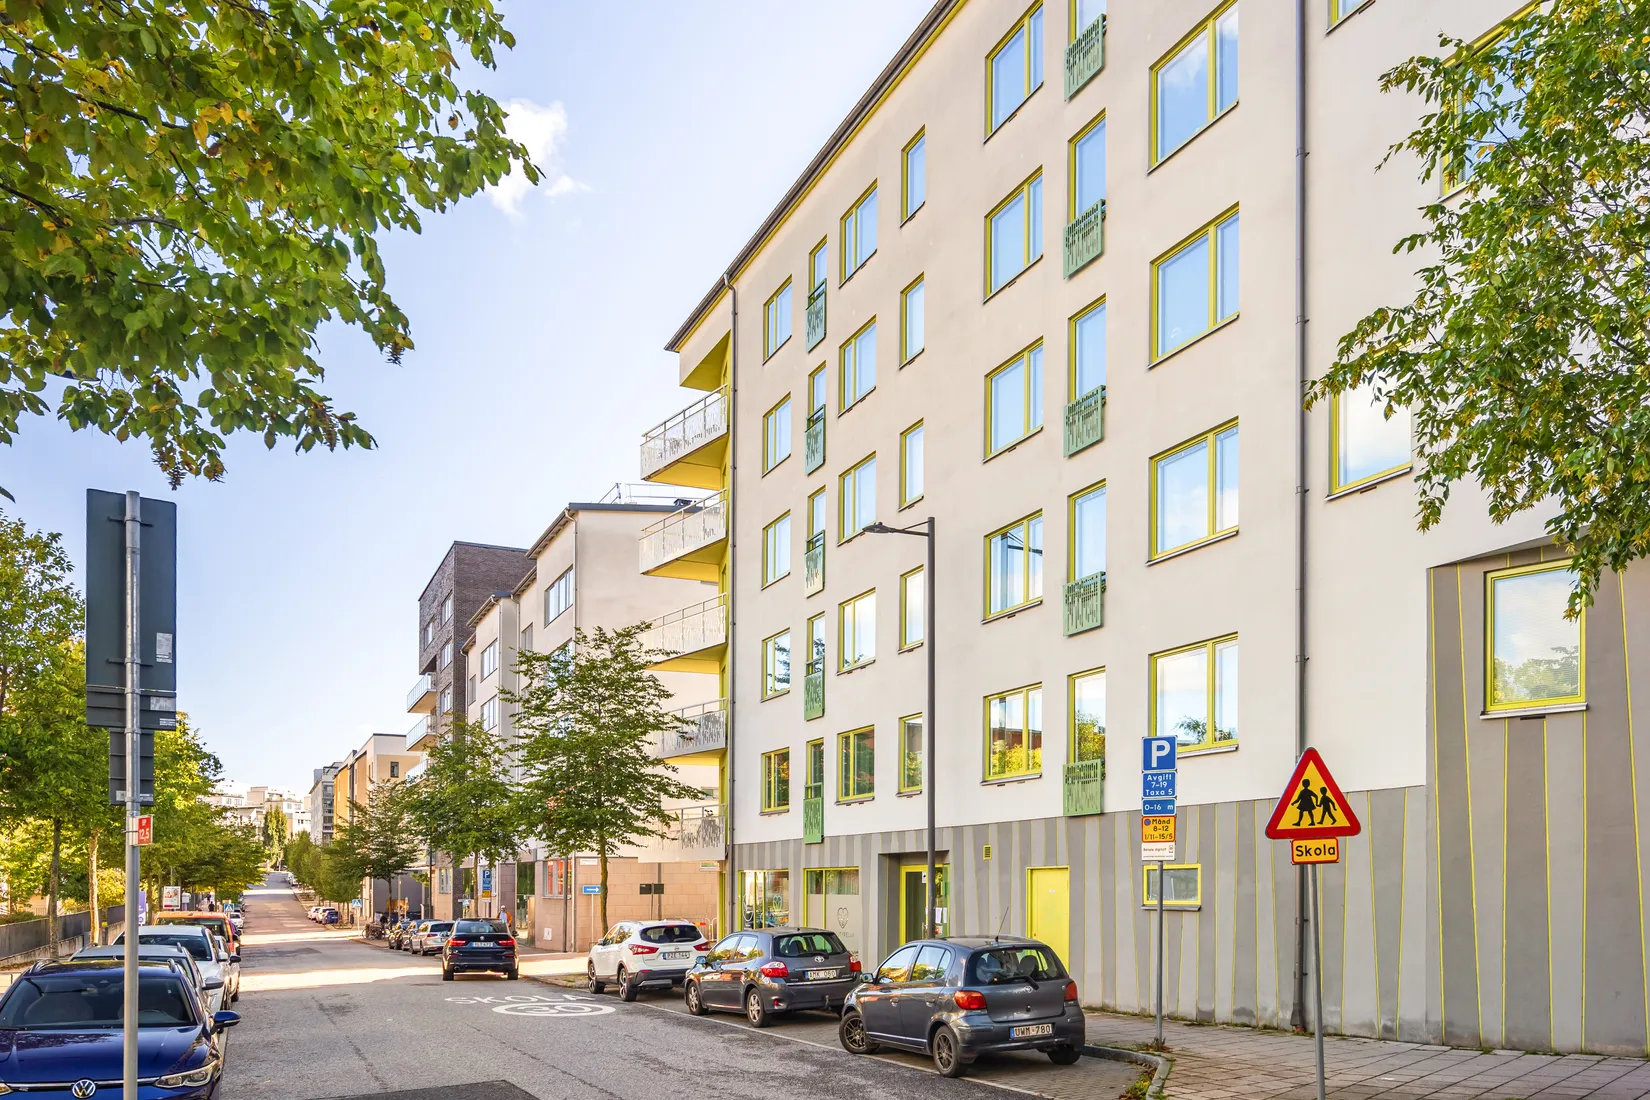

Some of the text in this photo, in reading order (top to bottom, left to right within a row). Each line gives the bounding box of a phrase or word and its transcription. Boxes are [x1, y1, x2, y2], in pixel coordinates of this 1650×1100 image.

[1151, 740, 1171, 768] P
[1147, 774, 1172, 782] Avgift
[1295, 844, 1336, 857] Skola
[445, 994, 596, 1005] SKOLA
[517, 1004, 593, 1014] 30
[1014, 1024, 1051, 1037] UWM 780
